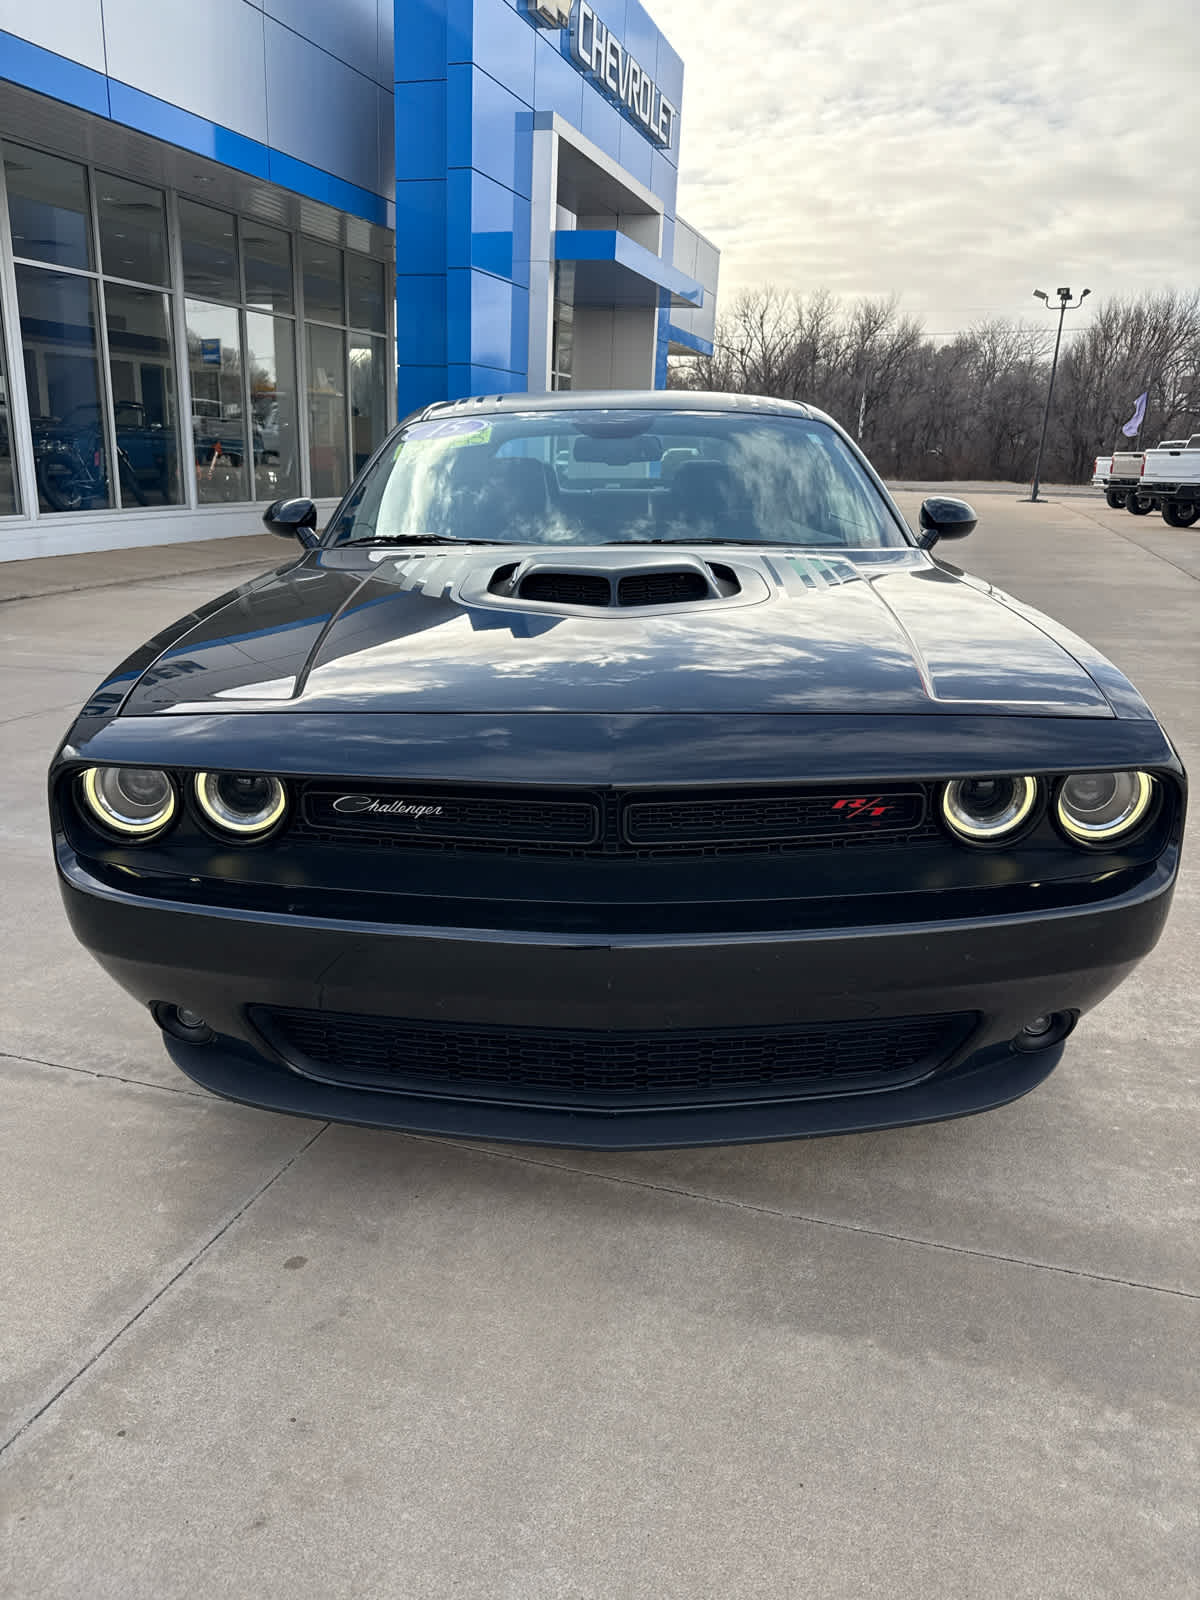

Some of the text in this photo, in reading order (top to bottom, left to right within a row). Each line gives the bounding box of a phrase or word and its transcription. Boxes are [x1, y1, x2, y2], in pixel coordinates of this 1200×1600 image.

[579, 2, 674, 149] CHEVROLET
[333, 795, 443, 819] Challenger
[832, 797, 895, 819] R/T
